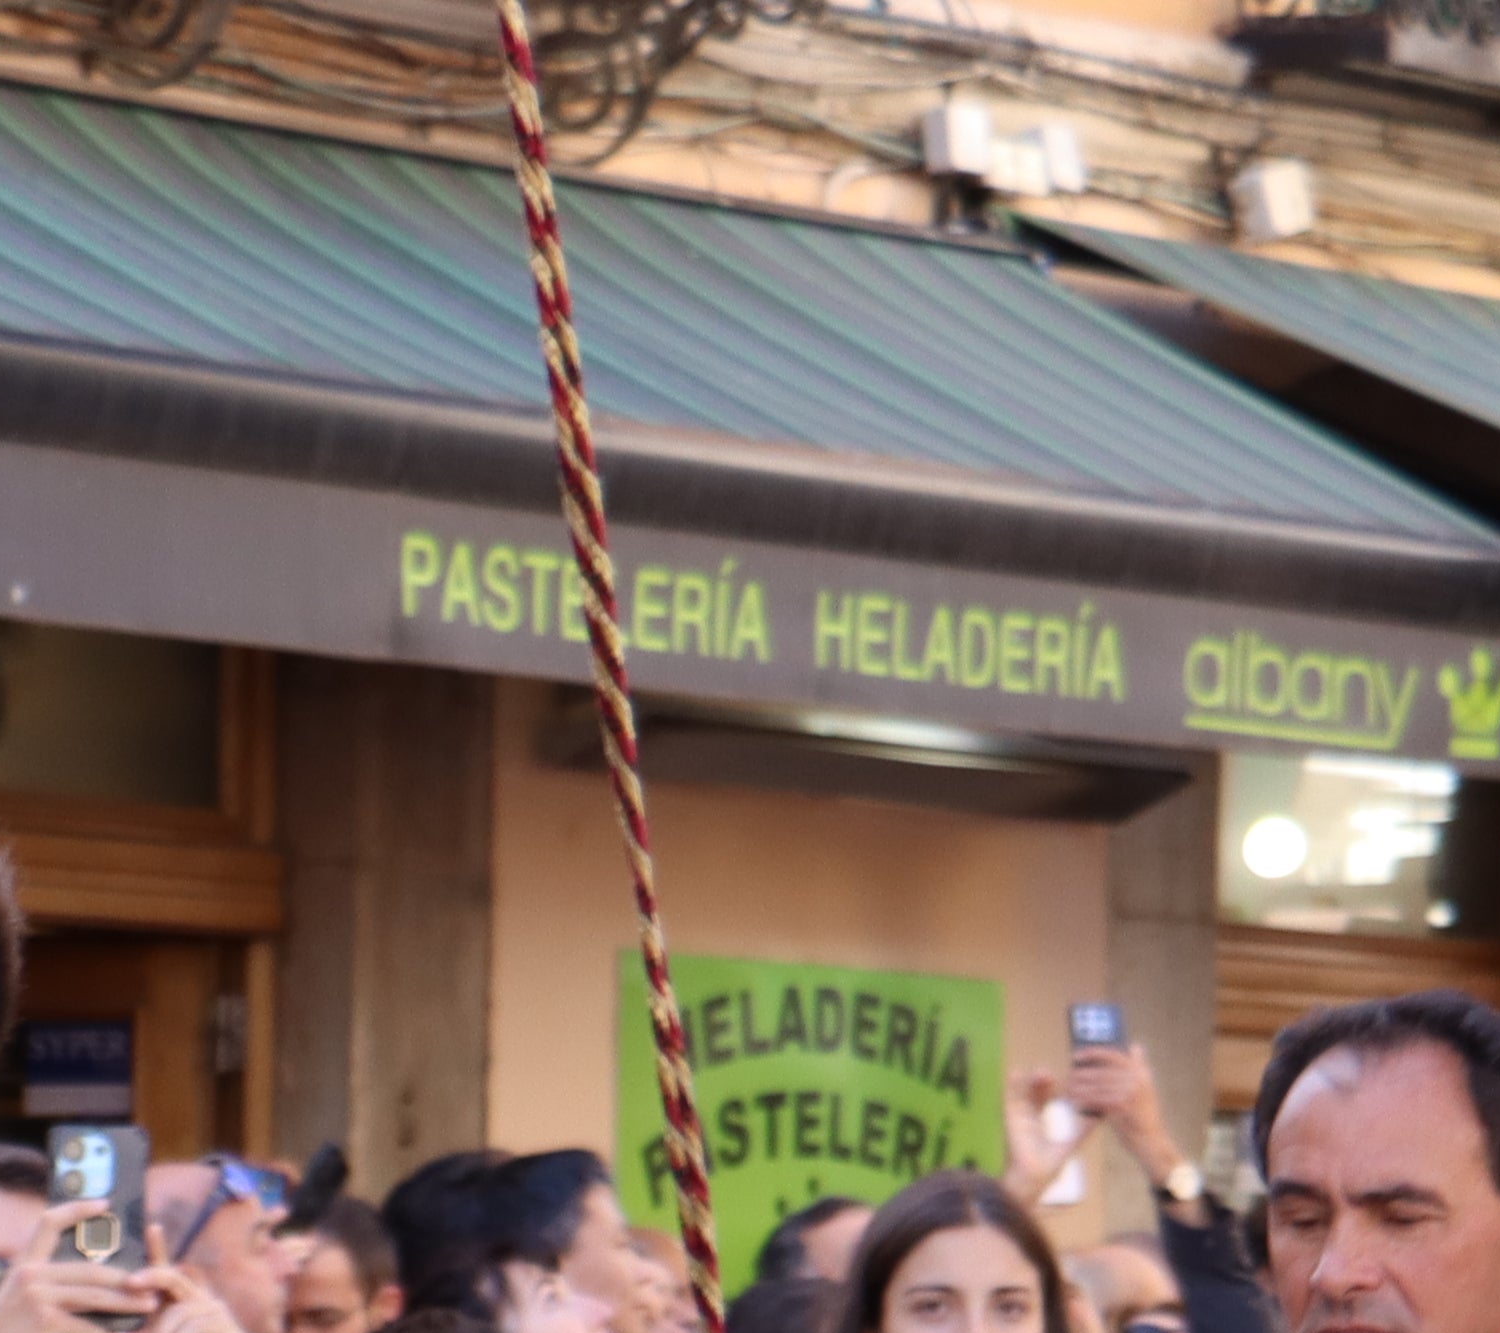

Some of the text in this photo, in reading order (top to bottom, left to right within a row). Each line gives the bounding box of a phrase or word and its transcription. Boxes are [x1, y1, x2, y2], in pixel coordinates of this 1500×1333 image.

[401, 529, 1420, 751] PASTEERÍA HELADERÍA albany
[643, 1091, 978, 1208] PSTELERÍ
